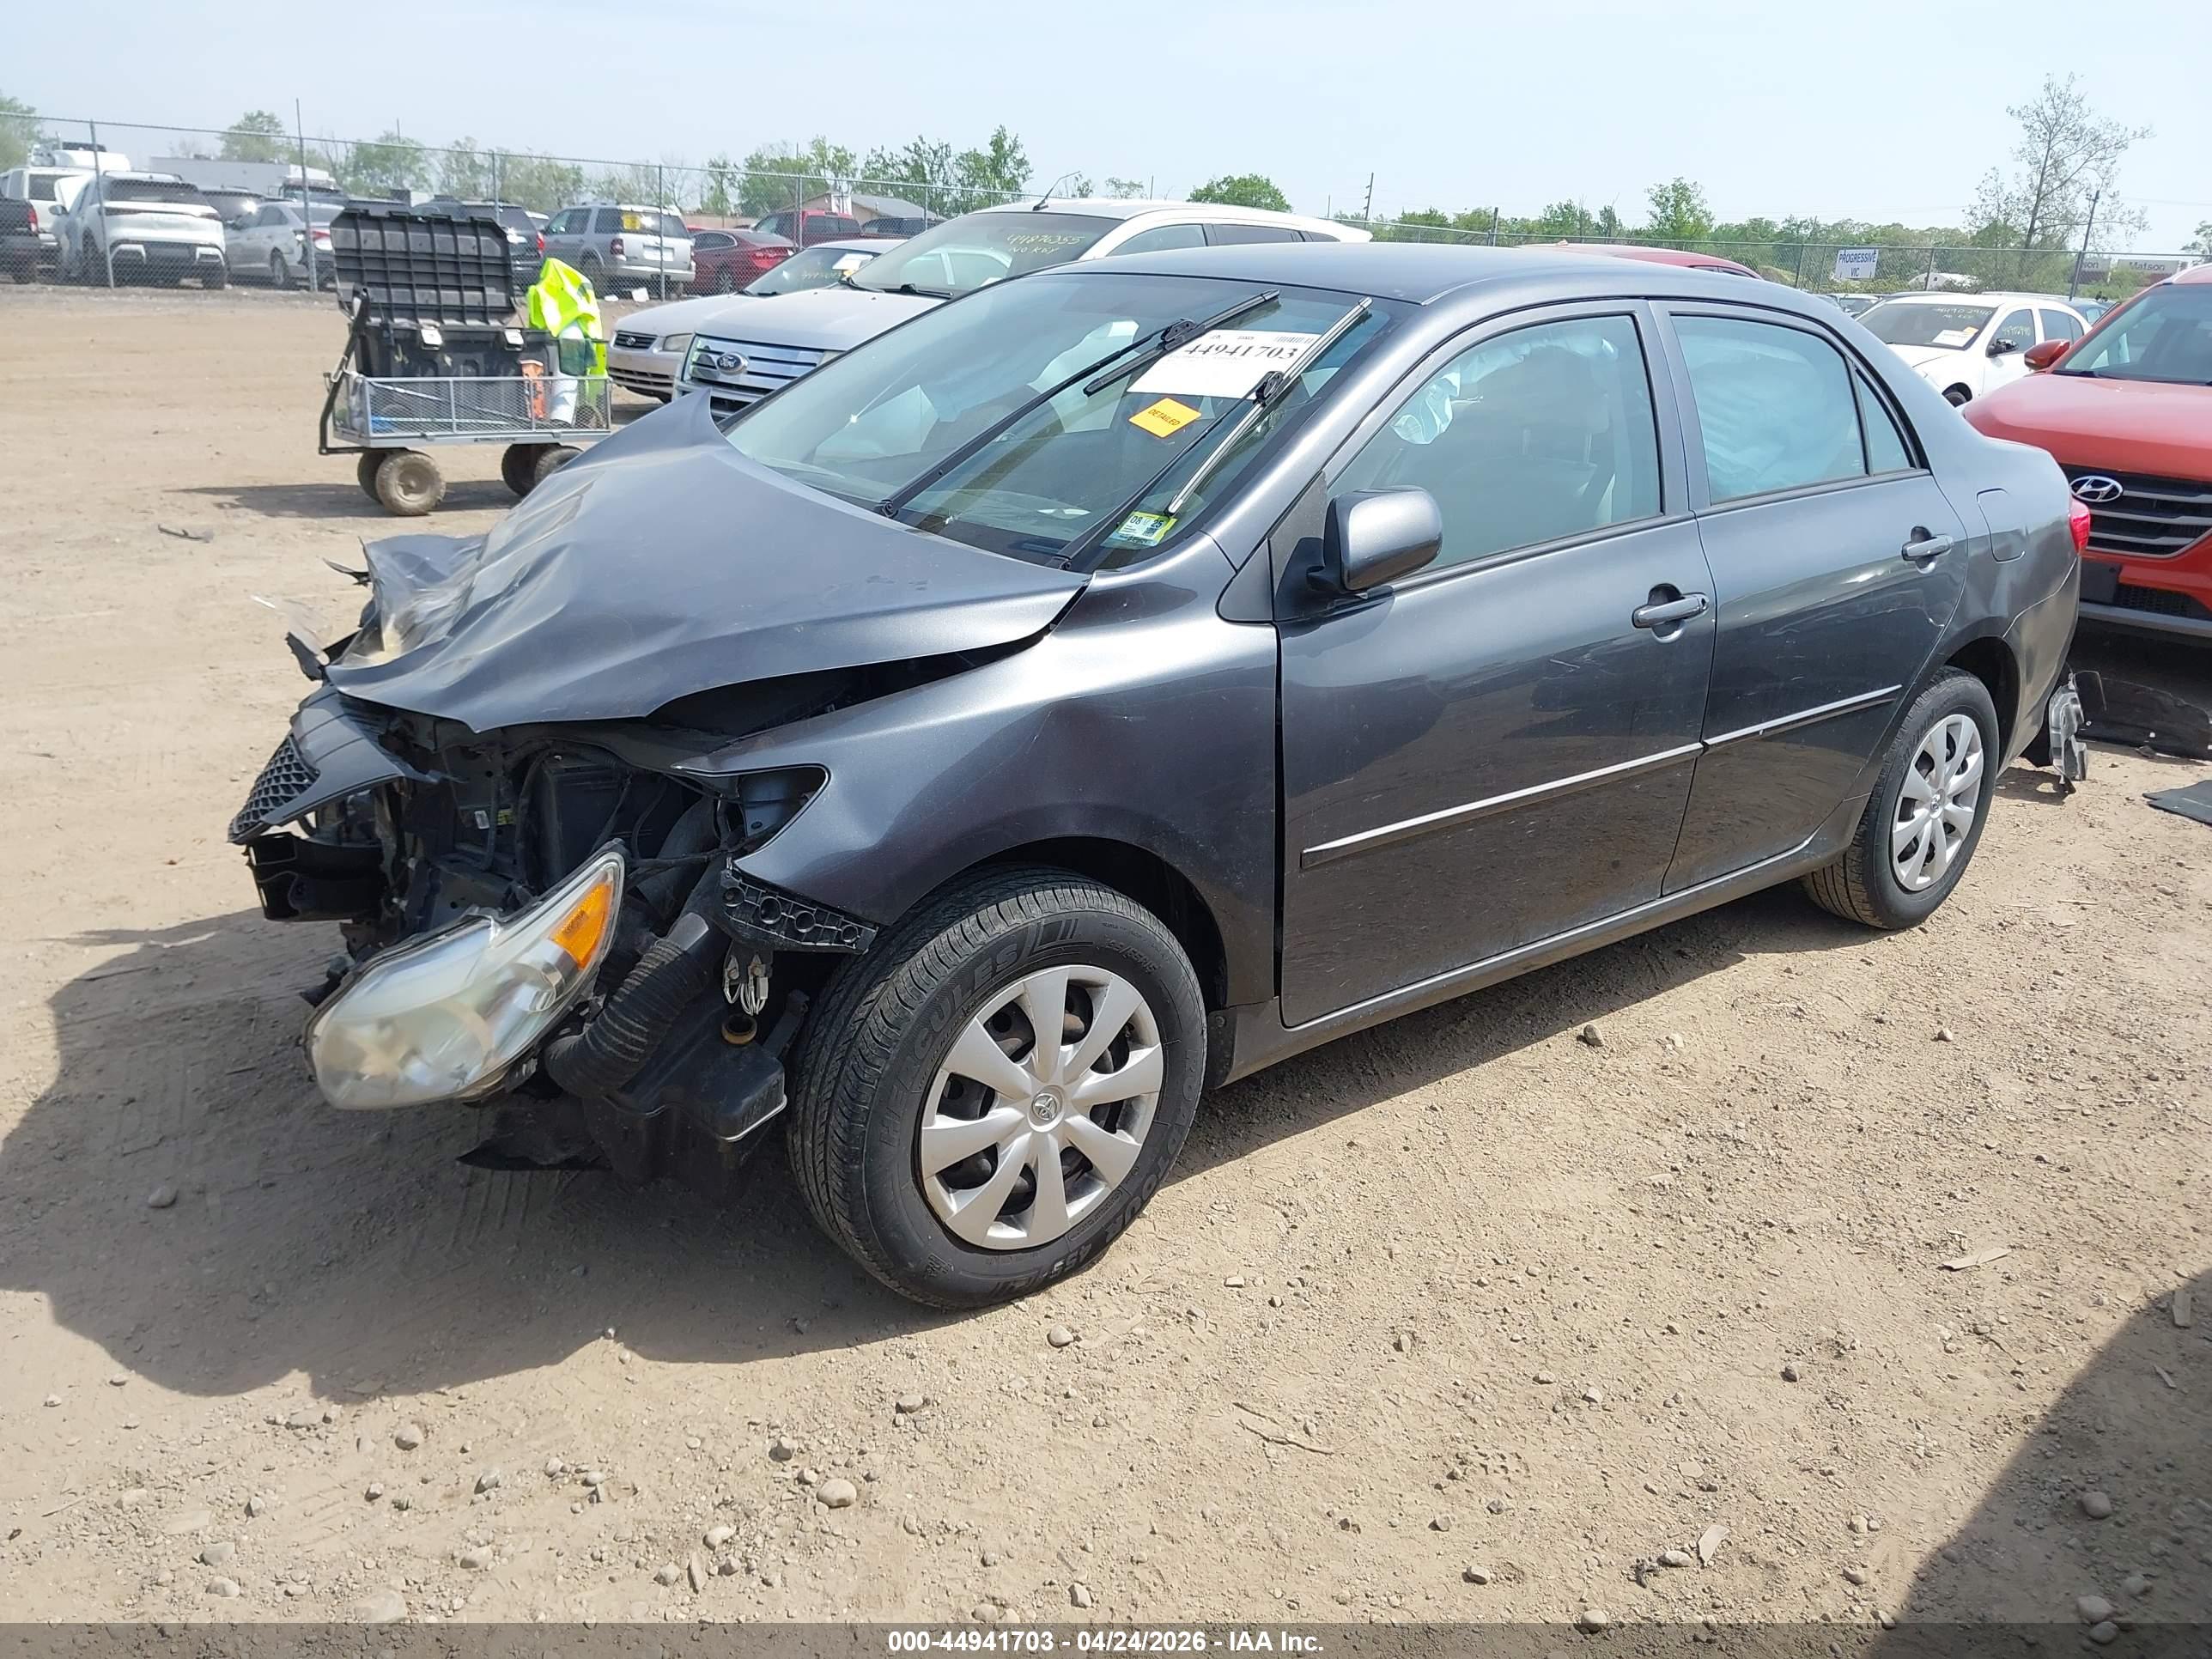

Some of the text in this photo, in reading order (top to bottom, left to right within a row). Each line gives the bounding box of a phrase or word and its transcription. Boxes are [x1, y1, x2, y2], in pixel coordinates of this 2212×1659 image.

[1838, 253, 1876, 263] PROGRESSIVE
[2130, 261, 2165, 270] Matson
[1850, 267, 1860, 276] VIC
[1185, 343, 1297, 359] 44941703
[1148, 409, 1181, 426] DETAILED
[1130, 516, 1164, 528] 08 25
